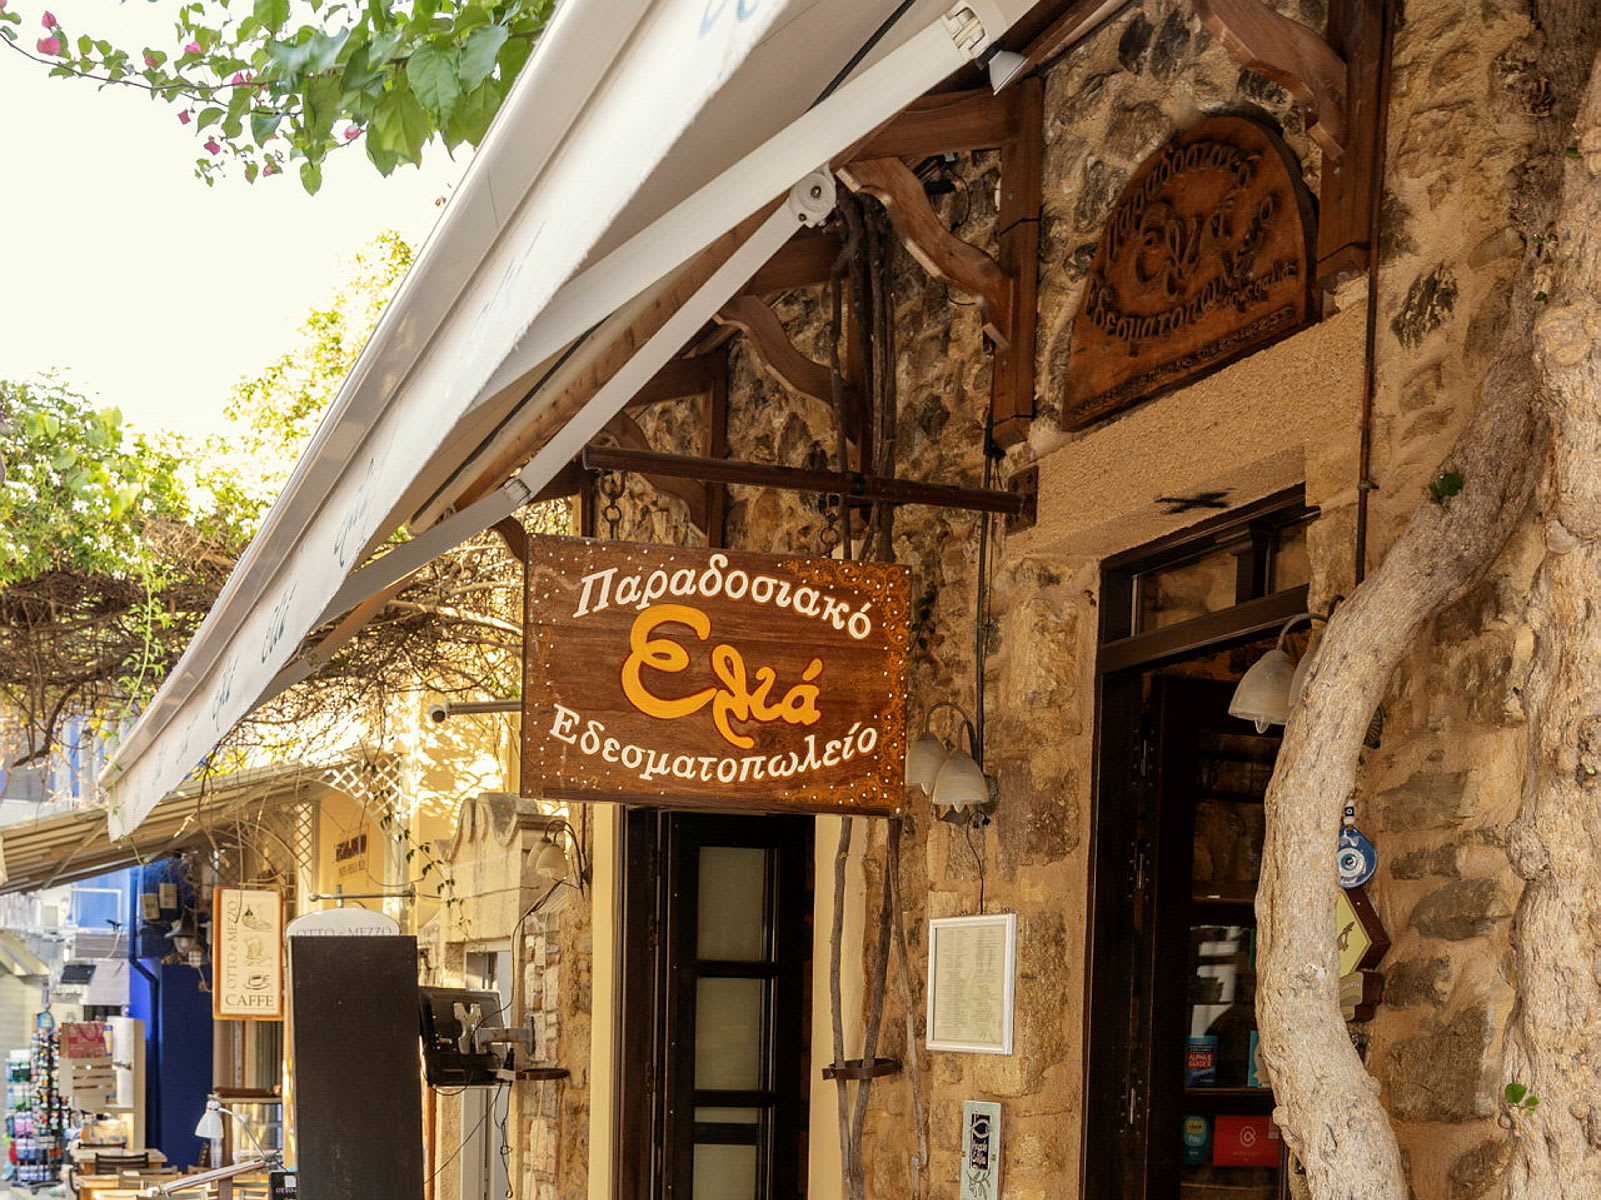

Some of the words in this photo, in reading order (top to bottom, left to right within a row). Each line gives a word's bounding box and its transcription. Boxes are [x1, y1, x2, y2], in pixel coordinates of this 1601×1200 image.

[572, 553, 874, 641] Παραδοσιακό
[621, 603, 824, 749] Ελιά
[549, 703, 878, 783] Εδεσματοπωλείο
[224, 993, 274, 1008] CAFFE
[227, 953, 238, 989] OTTO
